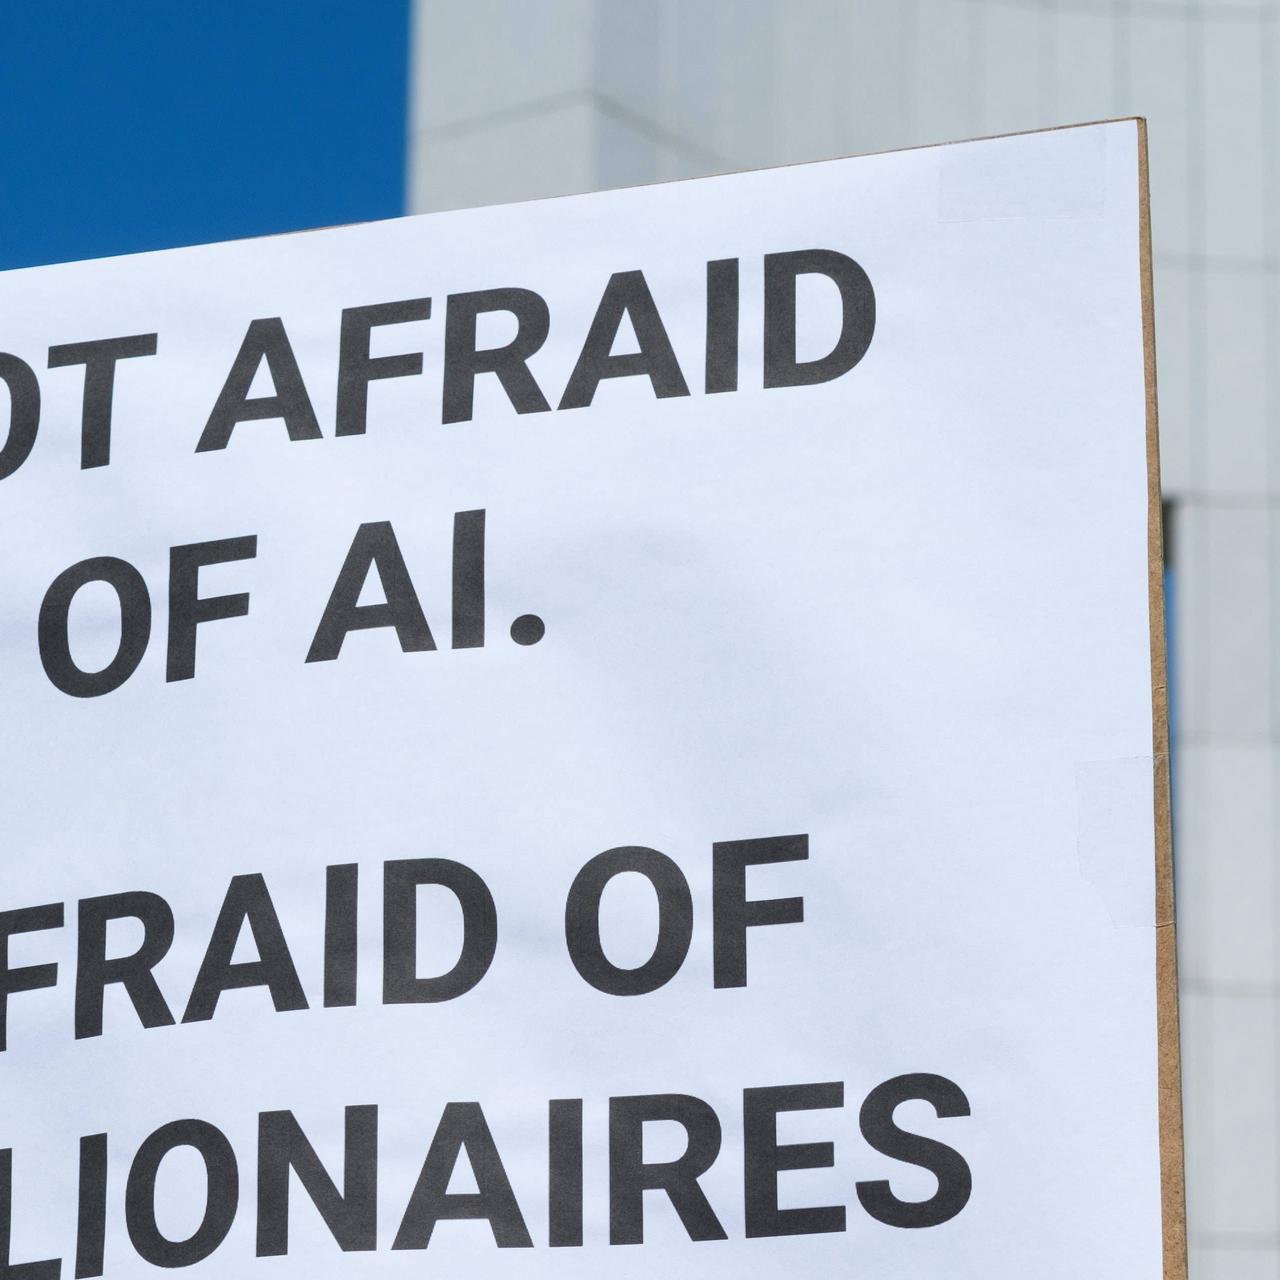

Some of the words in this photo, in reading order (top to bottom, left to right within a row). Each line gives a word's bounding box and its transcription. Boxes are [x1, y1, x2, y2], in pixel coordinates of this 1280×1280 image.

[195, 250, 876, 453] AFRAID
[38, 534, 258, 698] OF
[304, 509, 546, 664] AI.
[564, 833, 809, 996] OF
